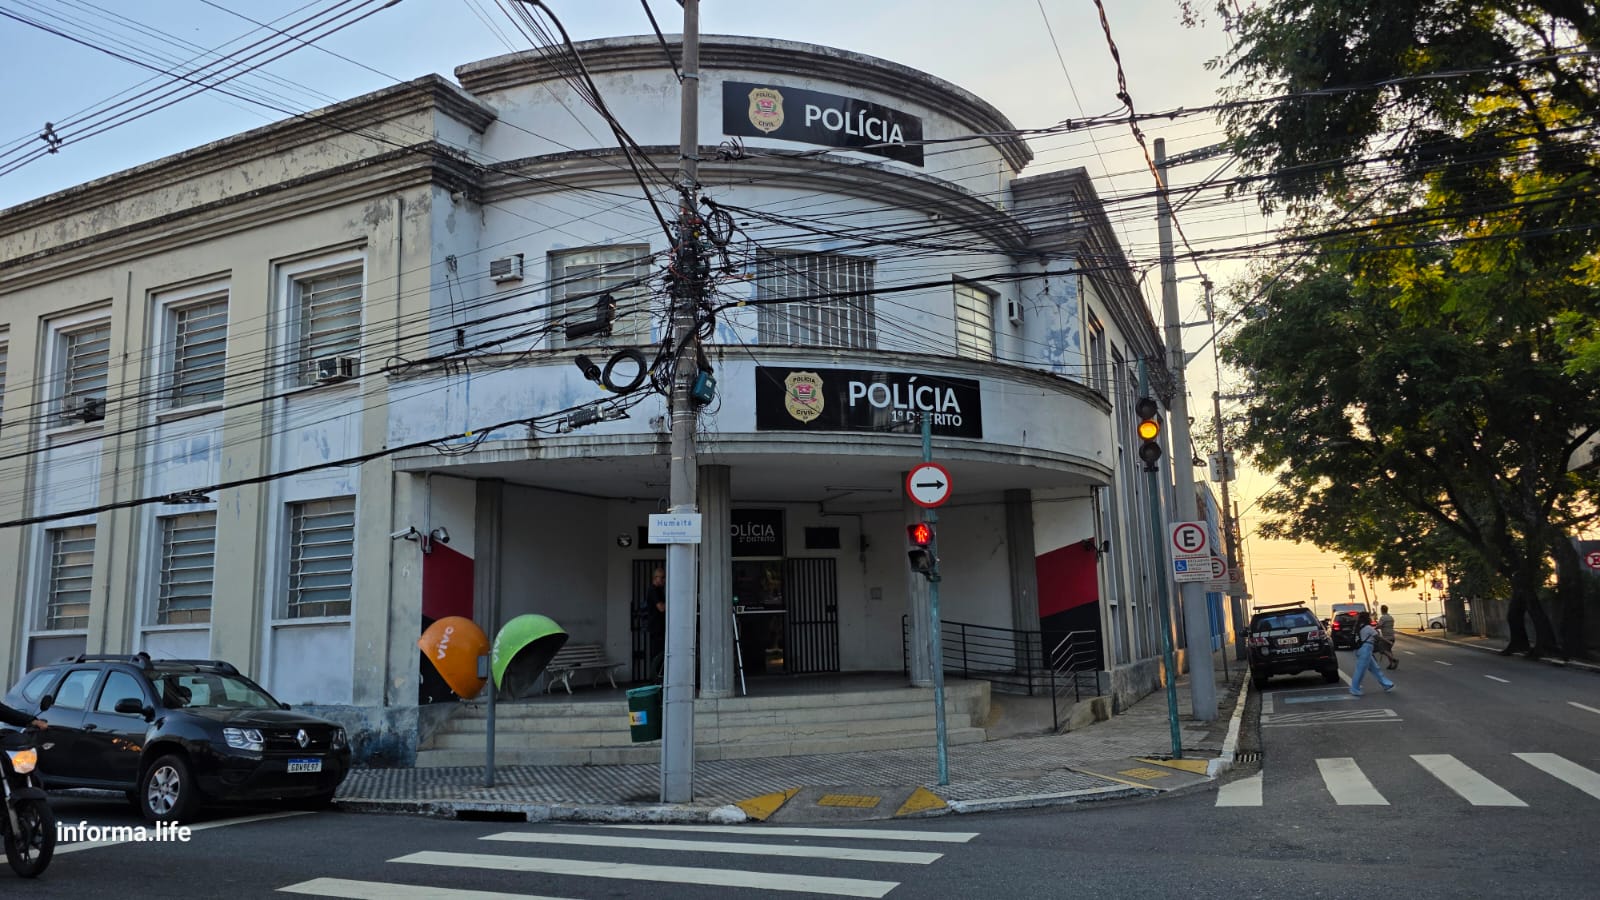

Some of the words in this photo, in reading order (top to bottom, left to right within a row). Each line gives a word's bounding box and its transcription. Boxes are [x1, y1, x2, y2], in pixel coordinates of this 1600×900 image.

[804, 103, 906, 147] POLÍCIA
[848, 376, 961, 413] POLÍCIA
[1183, 530, 1196, 547] E
[437, 626, 455, 660] vivo
